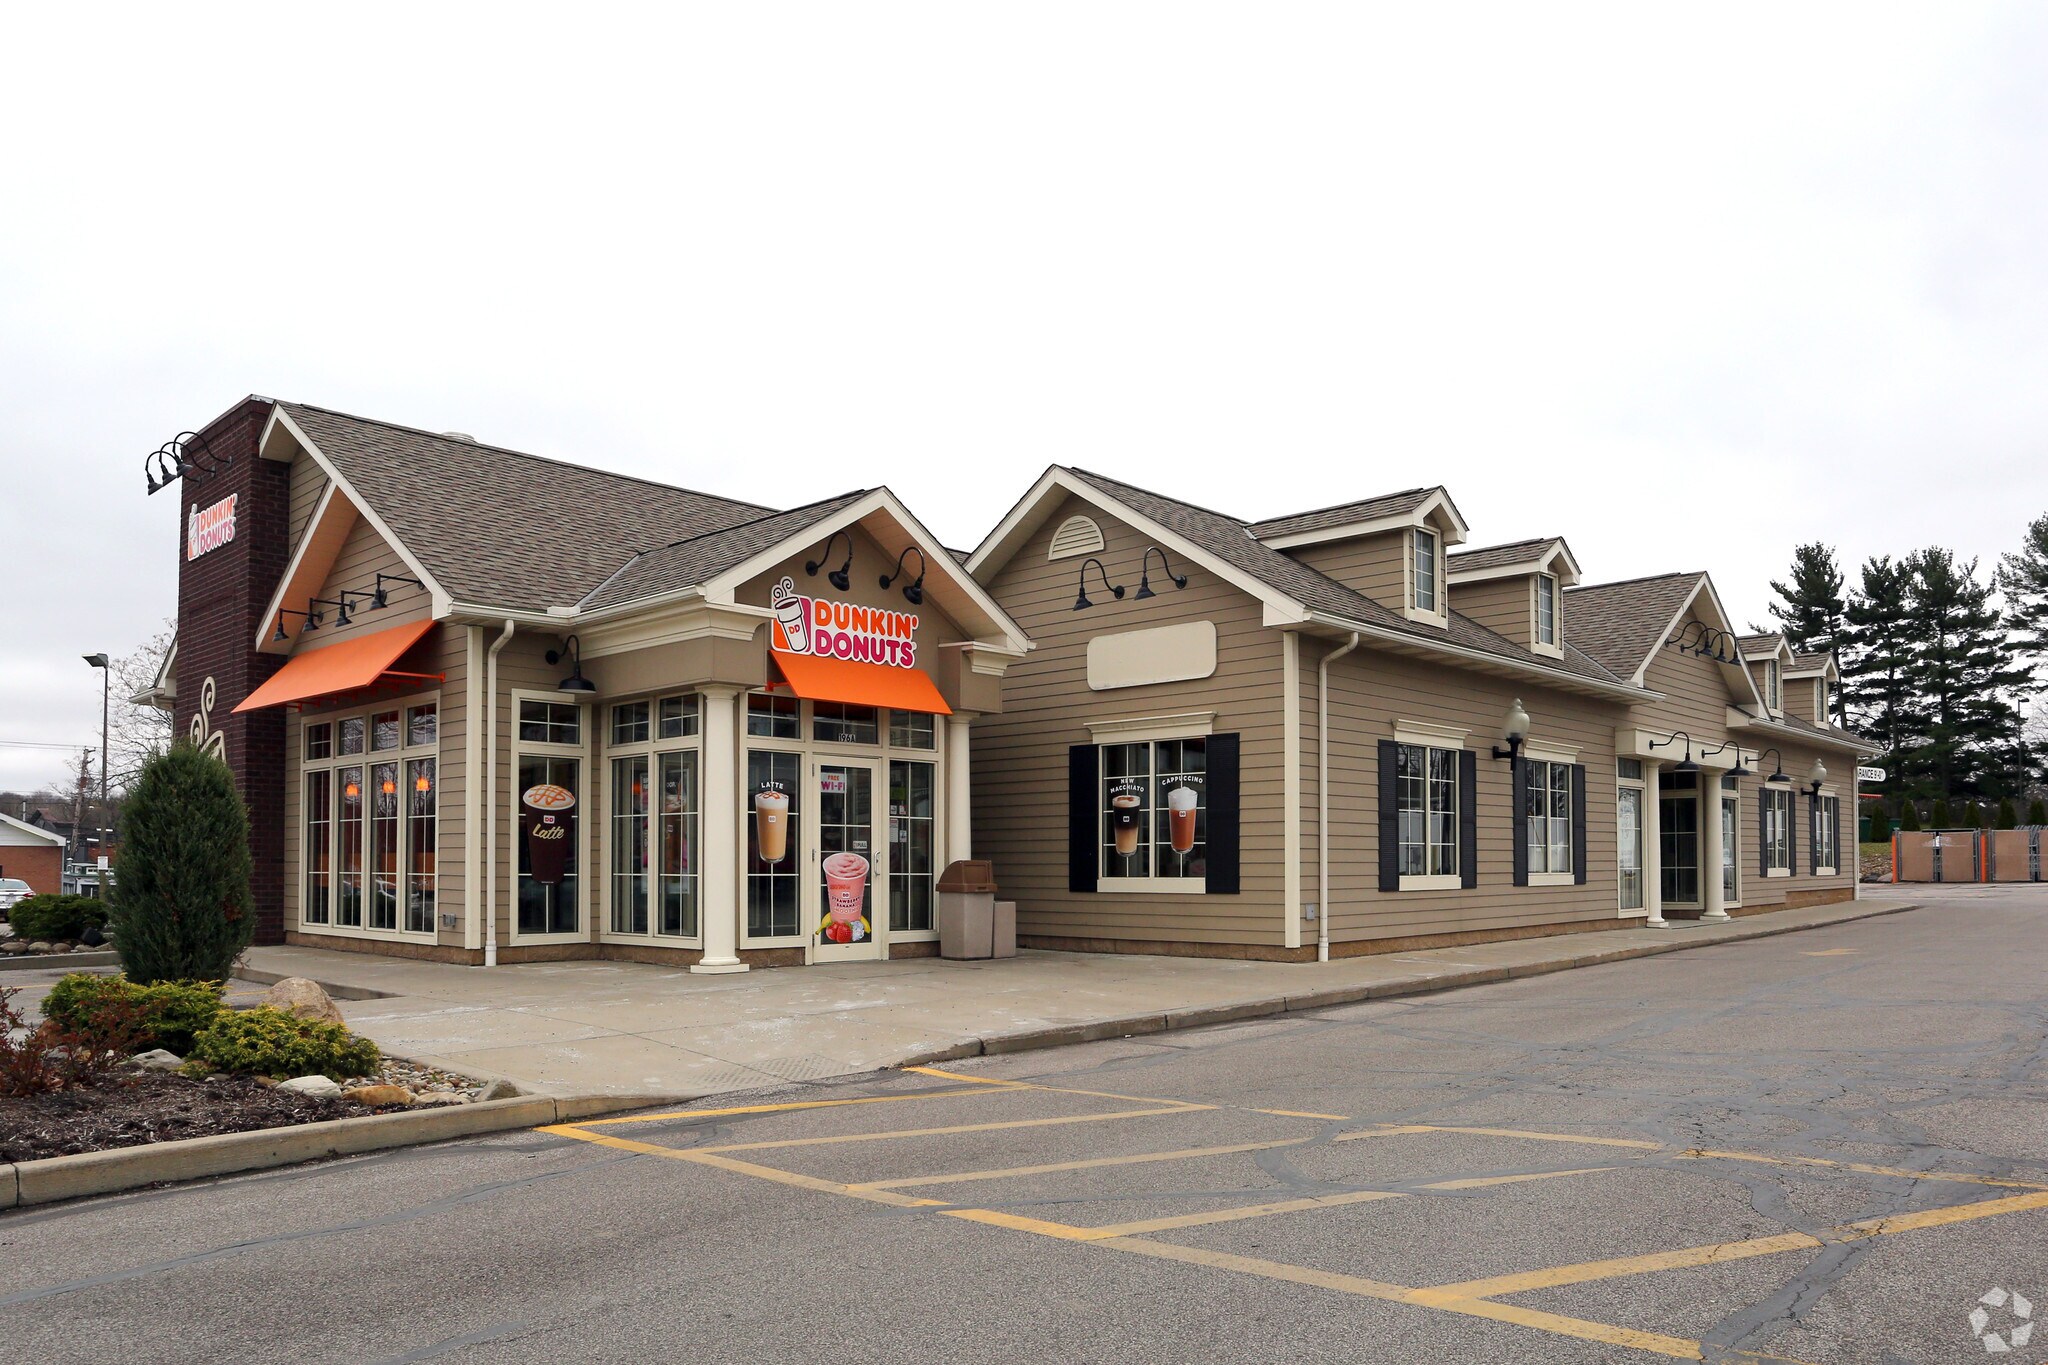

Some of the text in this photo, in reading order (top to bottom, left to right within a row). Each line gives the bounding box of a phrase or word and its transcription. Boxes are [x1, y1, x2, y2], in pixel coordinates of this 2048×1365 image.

[200, 496, 235, 532] DUNKIN'
[200, 518, 233, 553] DONUTS
[814, 600, 918, 640] DUNKIN'
[788, 624, 801, 635] DD
[815, 629, 914, 668] DONUTS
[760, 781, 784, 789] LATTE
[1161, 775, 1203, 786] CAPPUCCINO
[1110, 784, 1145, 794] MACCHIATO
[533, 824, 565, 839] Latte
